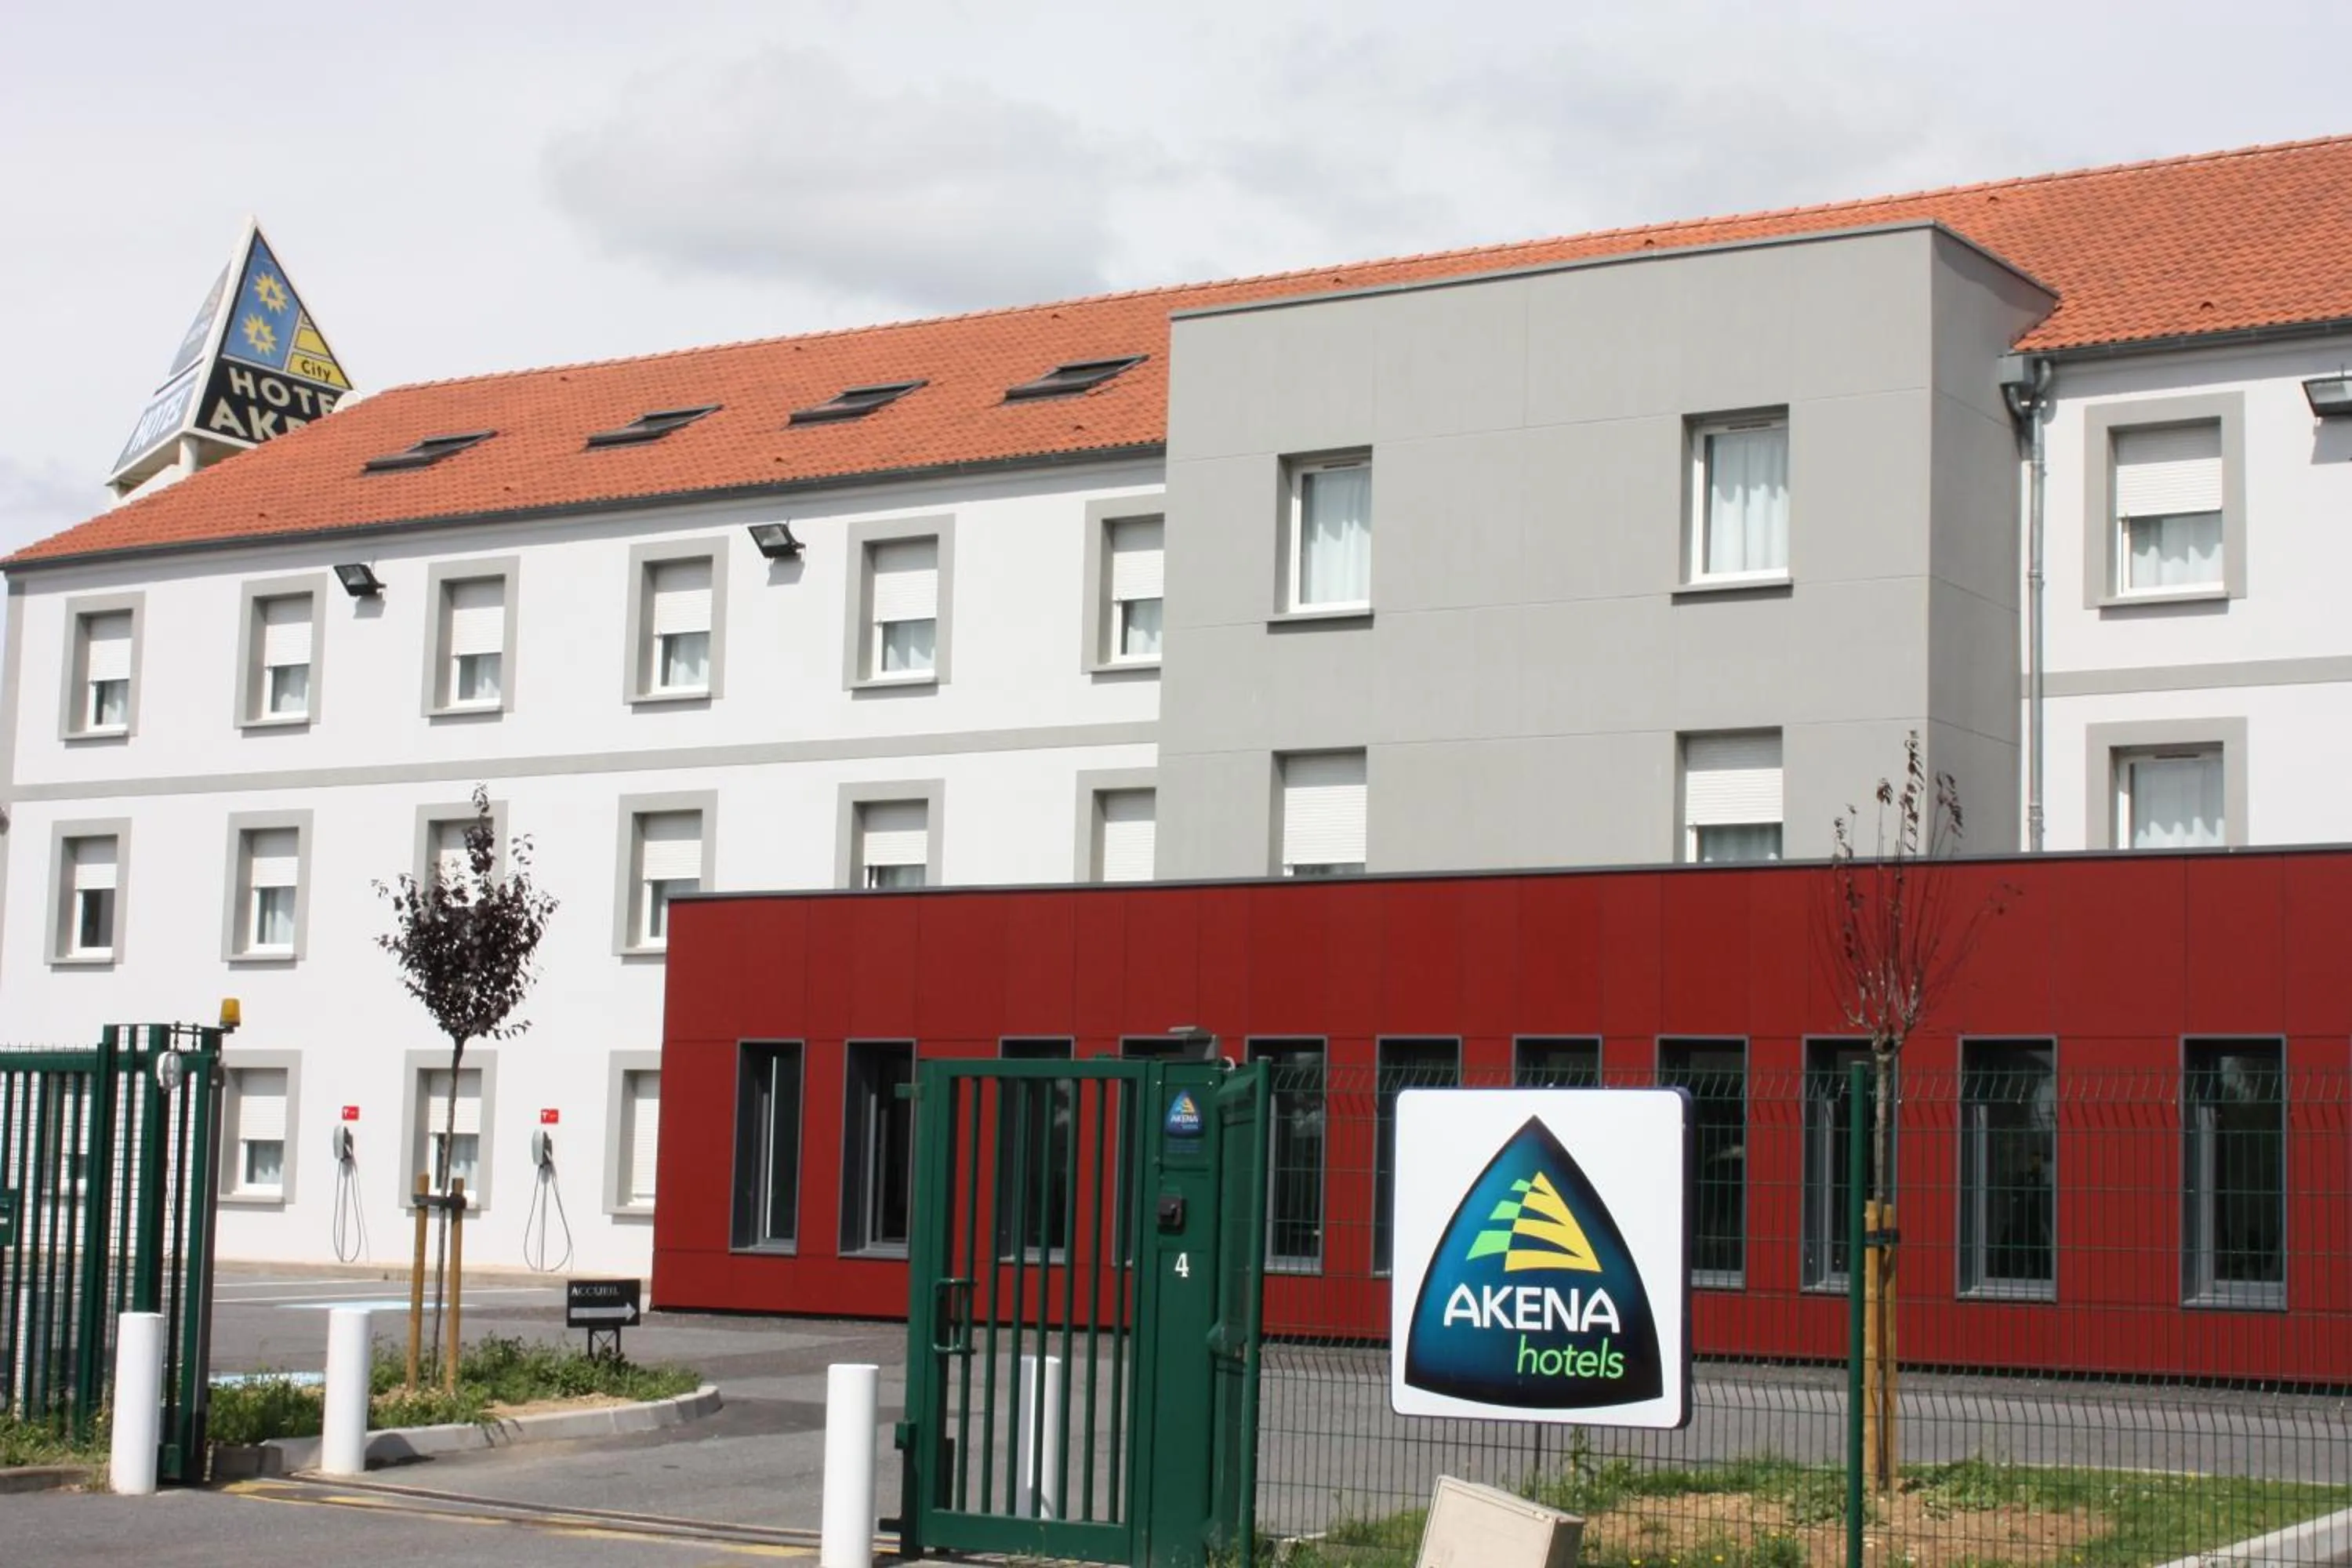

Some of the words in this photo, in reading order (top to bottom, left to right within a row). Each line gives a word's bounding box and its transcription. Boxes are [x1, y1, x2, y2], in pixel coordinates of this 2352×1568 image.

[300, 360, 331, 383] City
[1174, 1252, 1189, 1278] 4
[571, 1285, 621, 1297] ACCUEIL
[1443, 1283, 1621, 1333] AKENA
[1516, 1334, 1625, 1380] hotels
